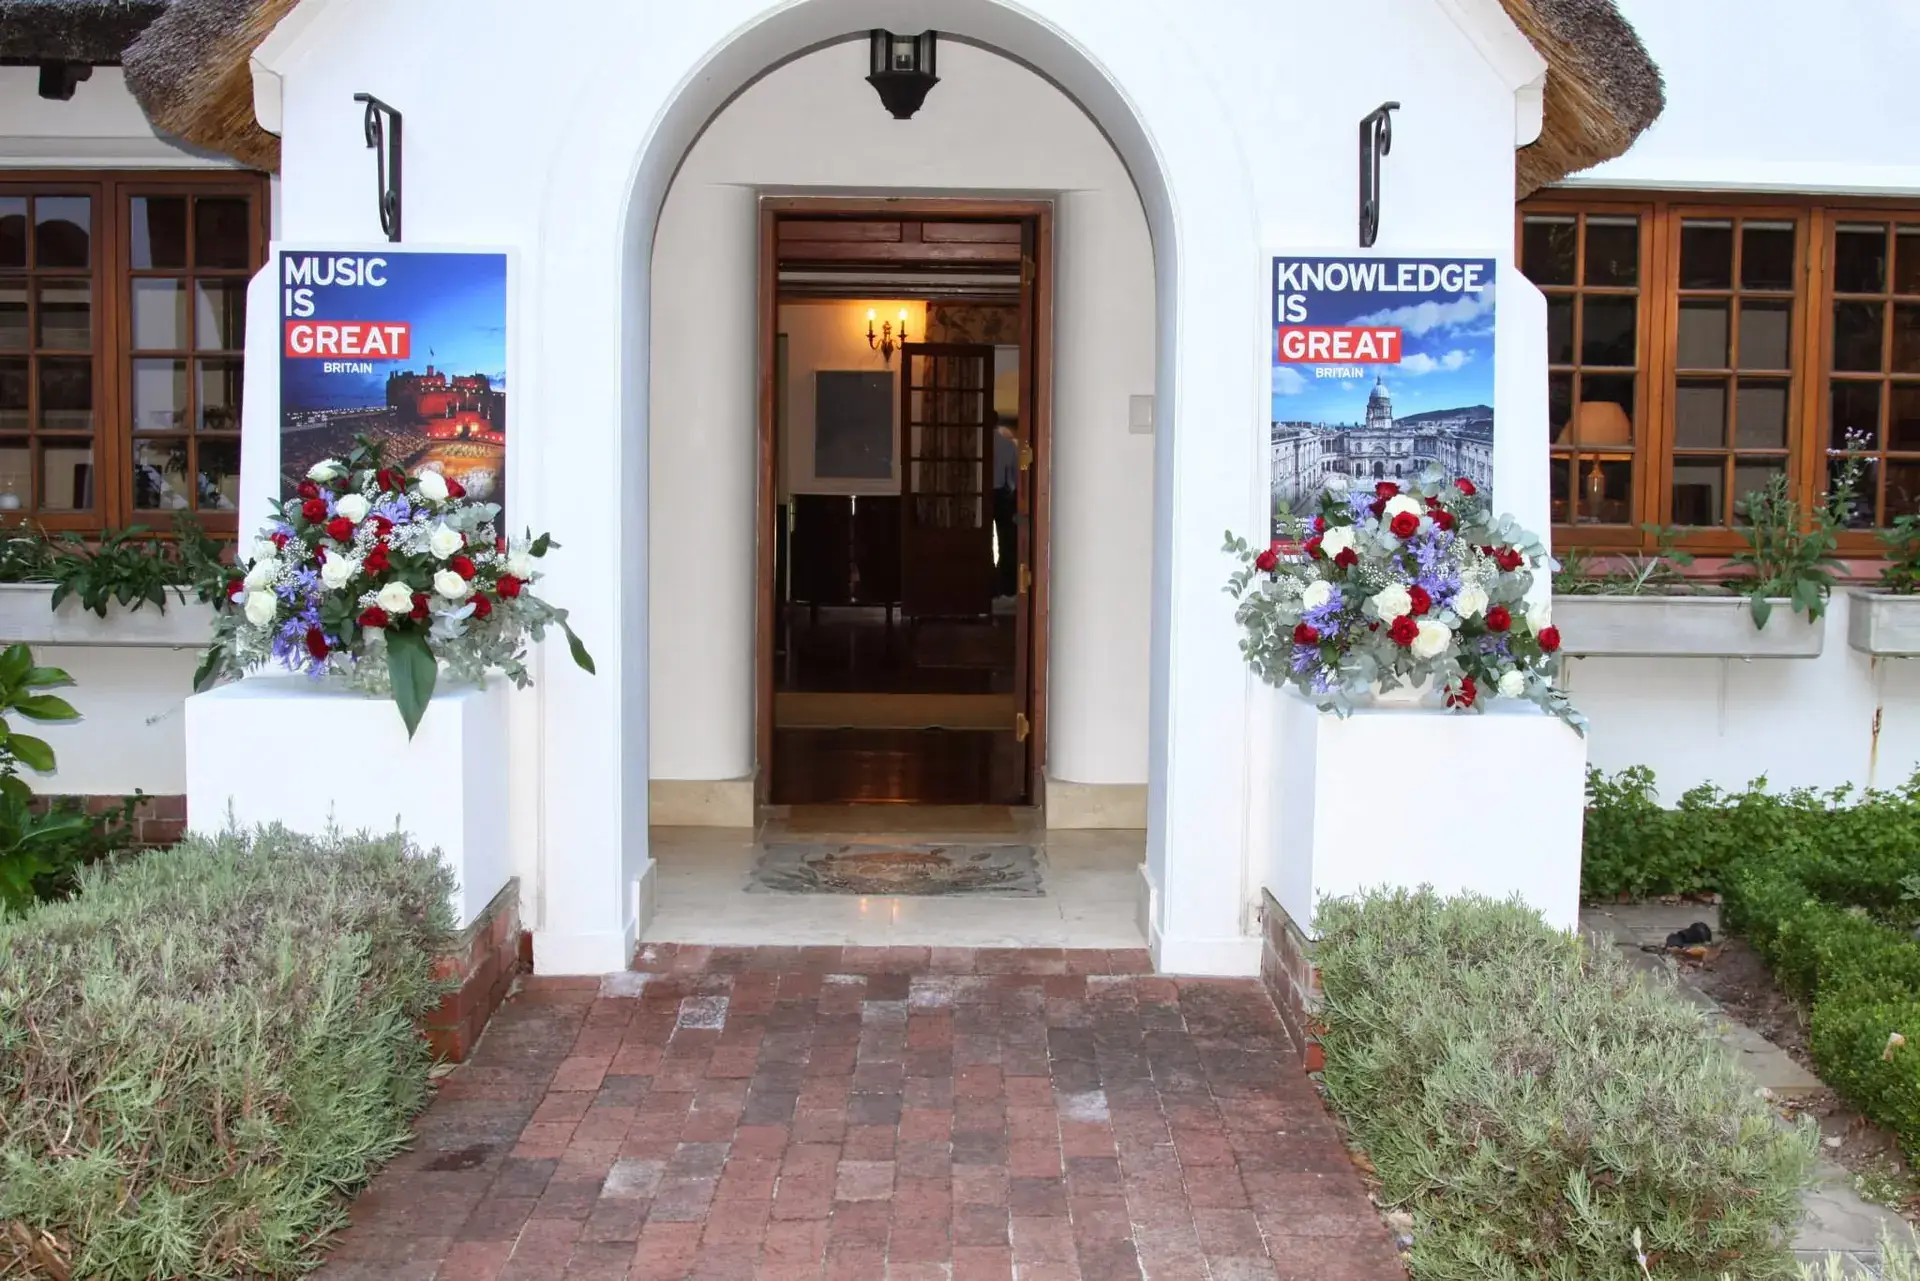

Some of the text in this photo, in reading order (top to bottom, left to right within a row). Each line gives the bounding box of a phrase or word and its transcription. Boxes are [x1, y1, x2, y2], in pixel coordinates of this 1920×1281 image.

[285, 257, 387, 286] MUSIC
[1278, 262, 1483, 292] KNOWLEDGE
[285, 288, 315, 317] IS
[1278, 294, 1307, 322] IS
[290, 325, 406, 355] GREAT
[1282, 330, 1397, 359] GREAT
[323, 361, 372, 374] BRITAIN
[1315, 367, 1364, 378] BRITAIN
